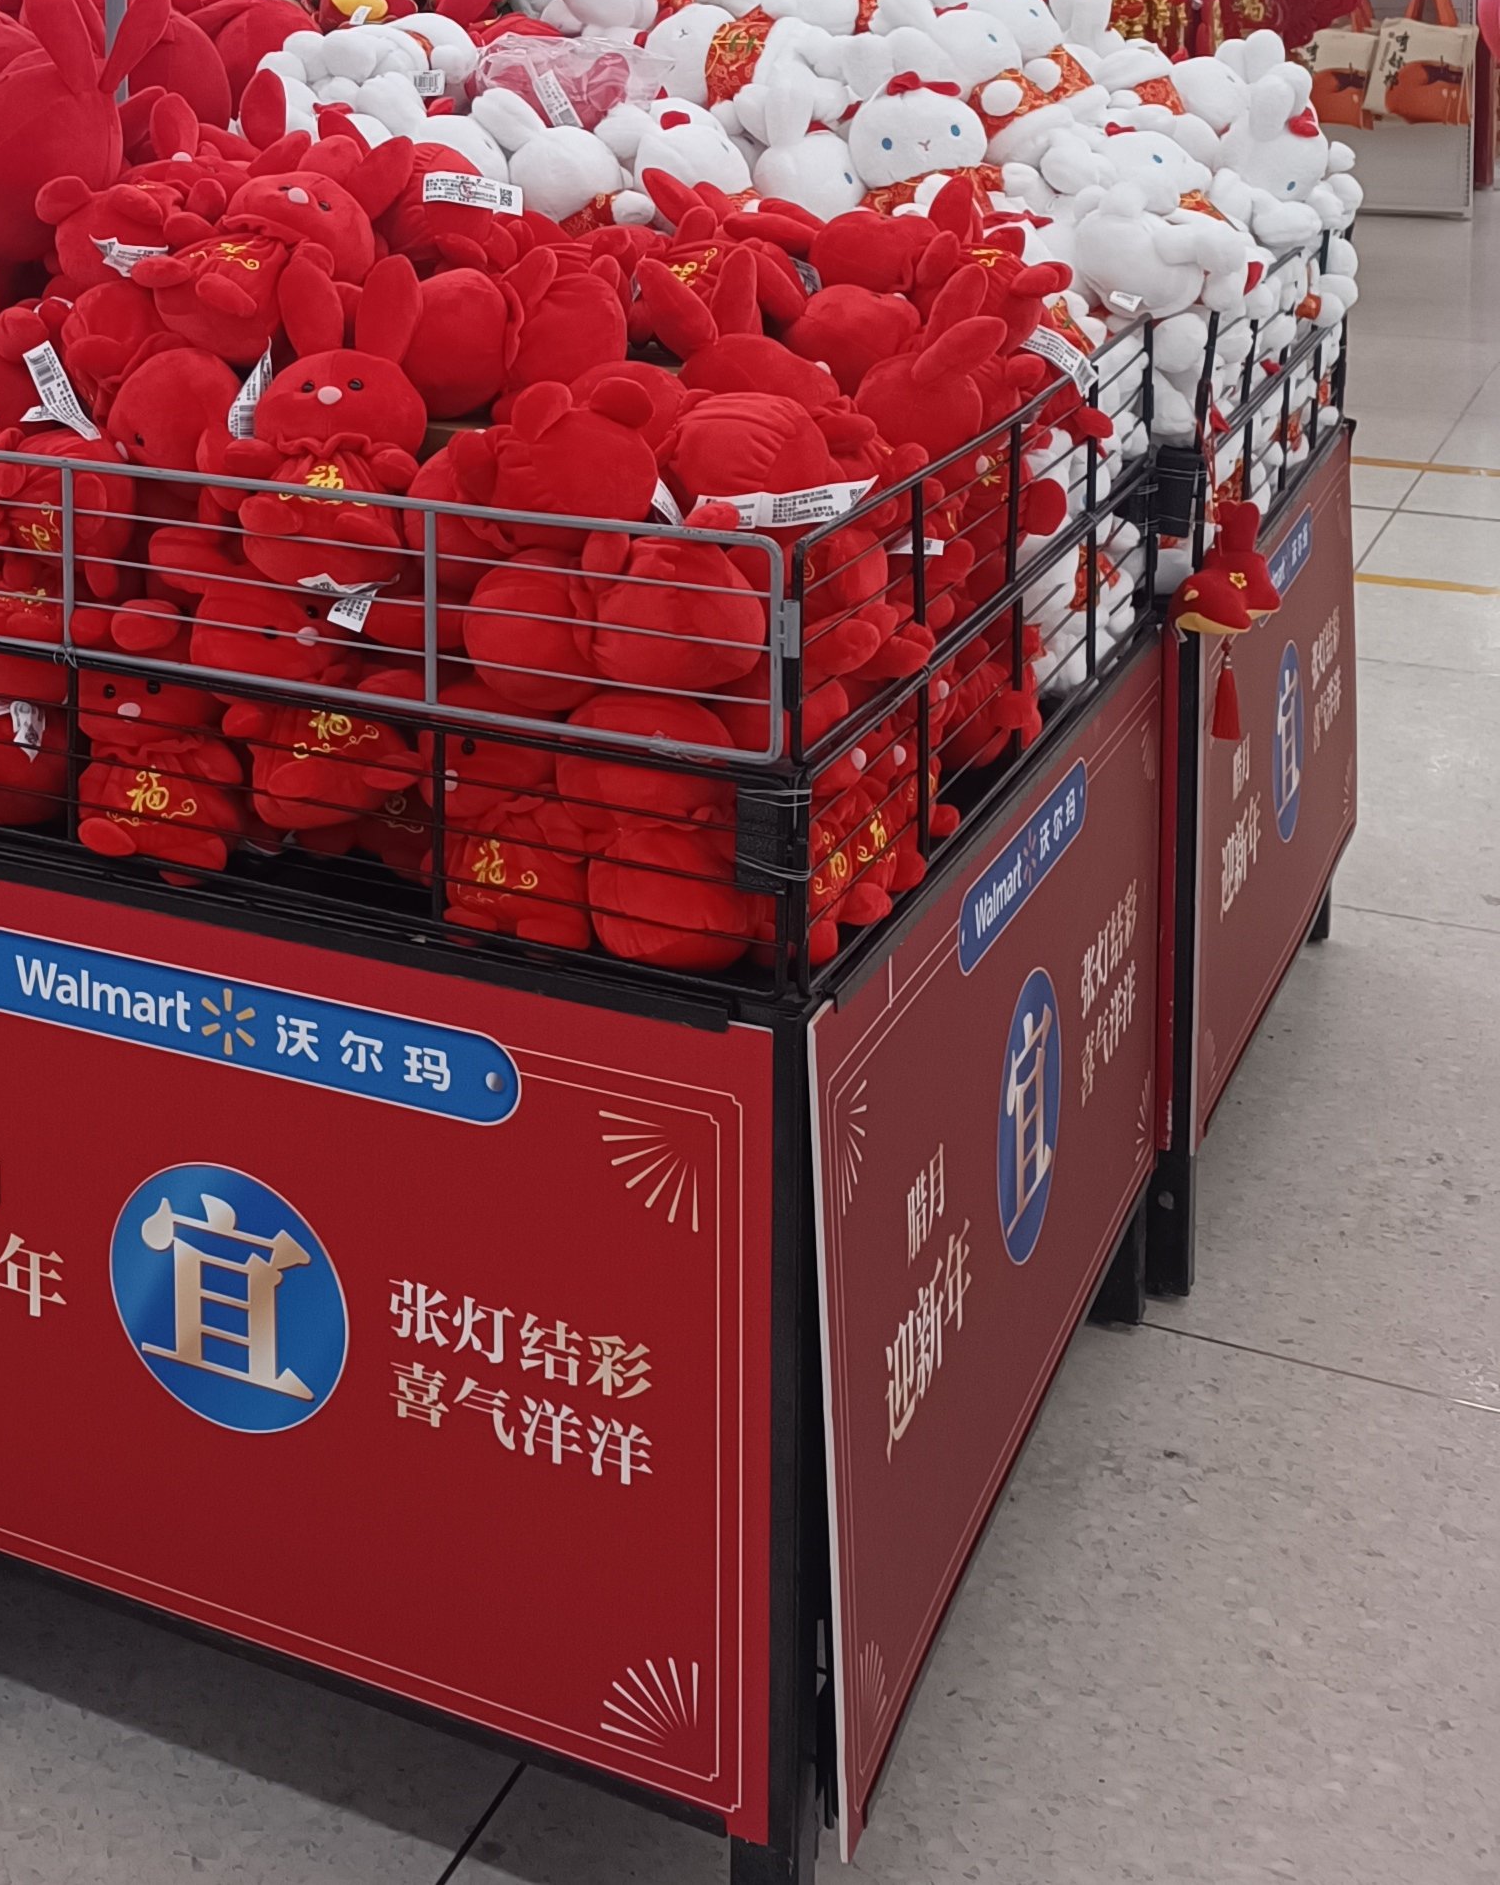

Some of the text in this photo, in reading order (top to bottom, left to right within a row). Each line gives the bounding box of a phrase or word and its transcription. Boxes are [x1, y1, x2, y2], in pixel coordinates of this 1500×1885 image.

[126, 765, 169, 813] 福
[1277, 668, 1300, 820] 宜
[974, 787, 1077, 940] Walmart 沃尔玛
[1220, 791, 1262, 924] 迎新年
[1080, 878, 1137, 1021] 张灯结彩
[15, 954, 452, 1093] Walmart 沃尔玛
[1080, 960, 1136, 1109] 喜气洋洋
[1007, 1003, 1053, 1240] 宜
[906, 1142, 945, 1269] 腊月
[140, 1192, 316, 1402] 宜
[388, 1279, 653, 1403] 张灯结彩
[885, 1217, 972, 1465] 迎新年
[388, 1361, 654, 1488] 喜气洋洋
